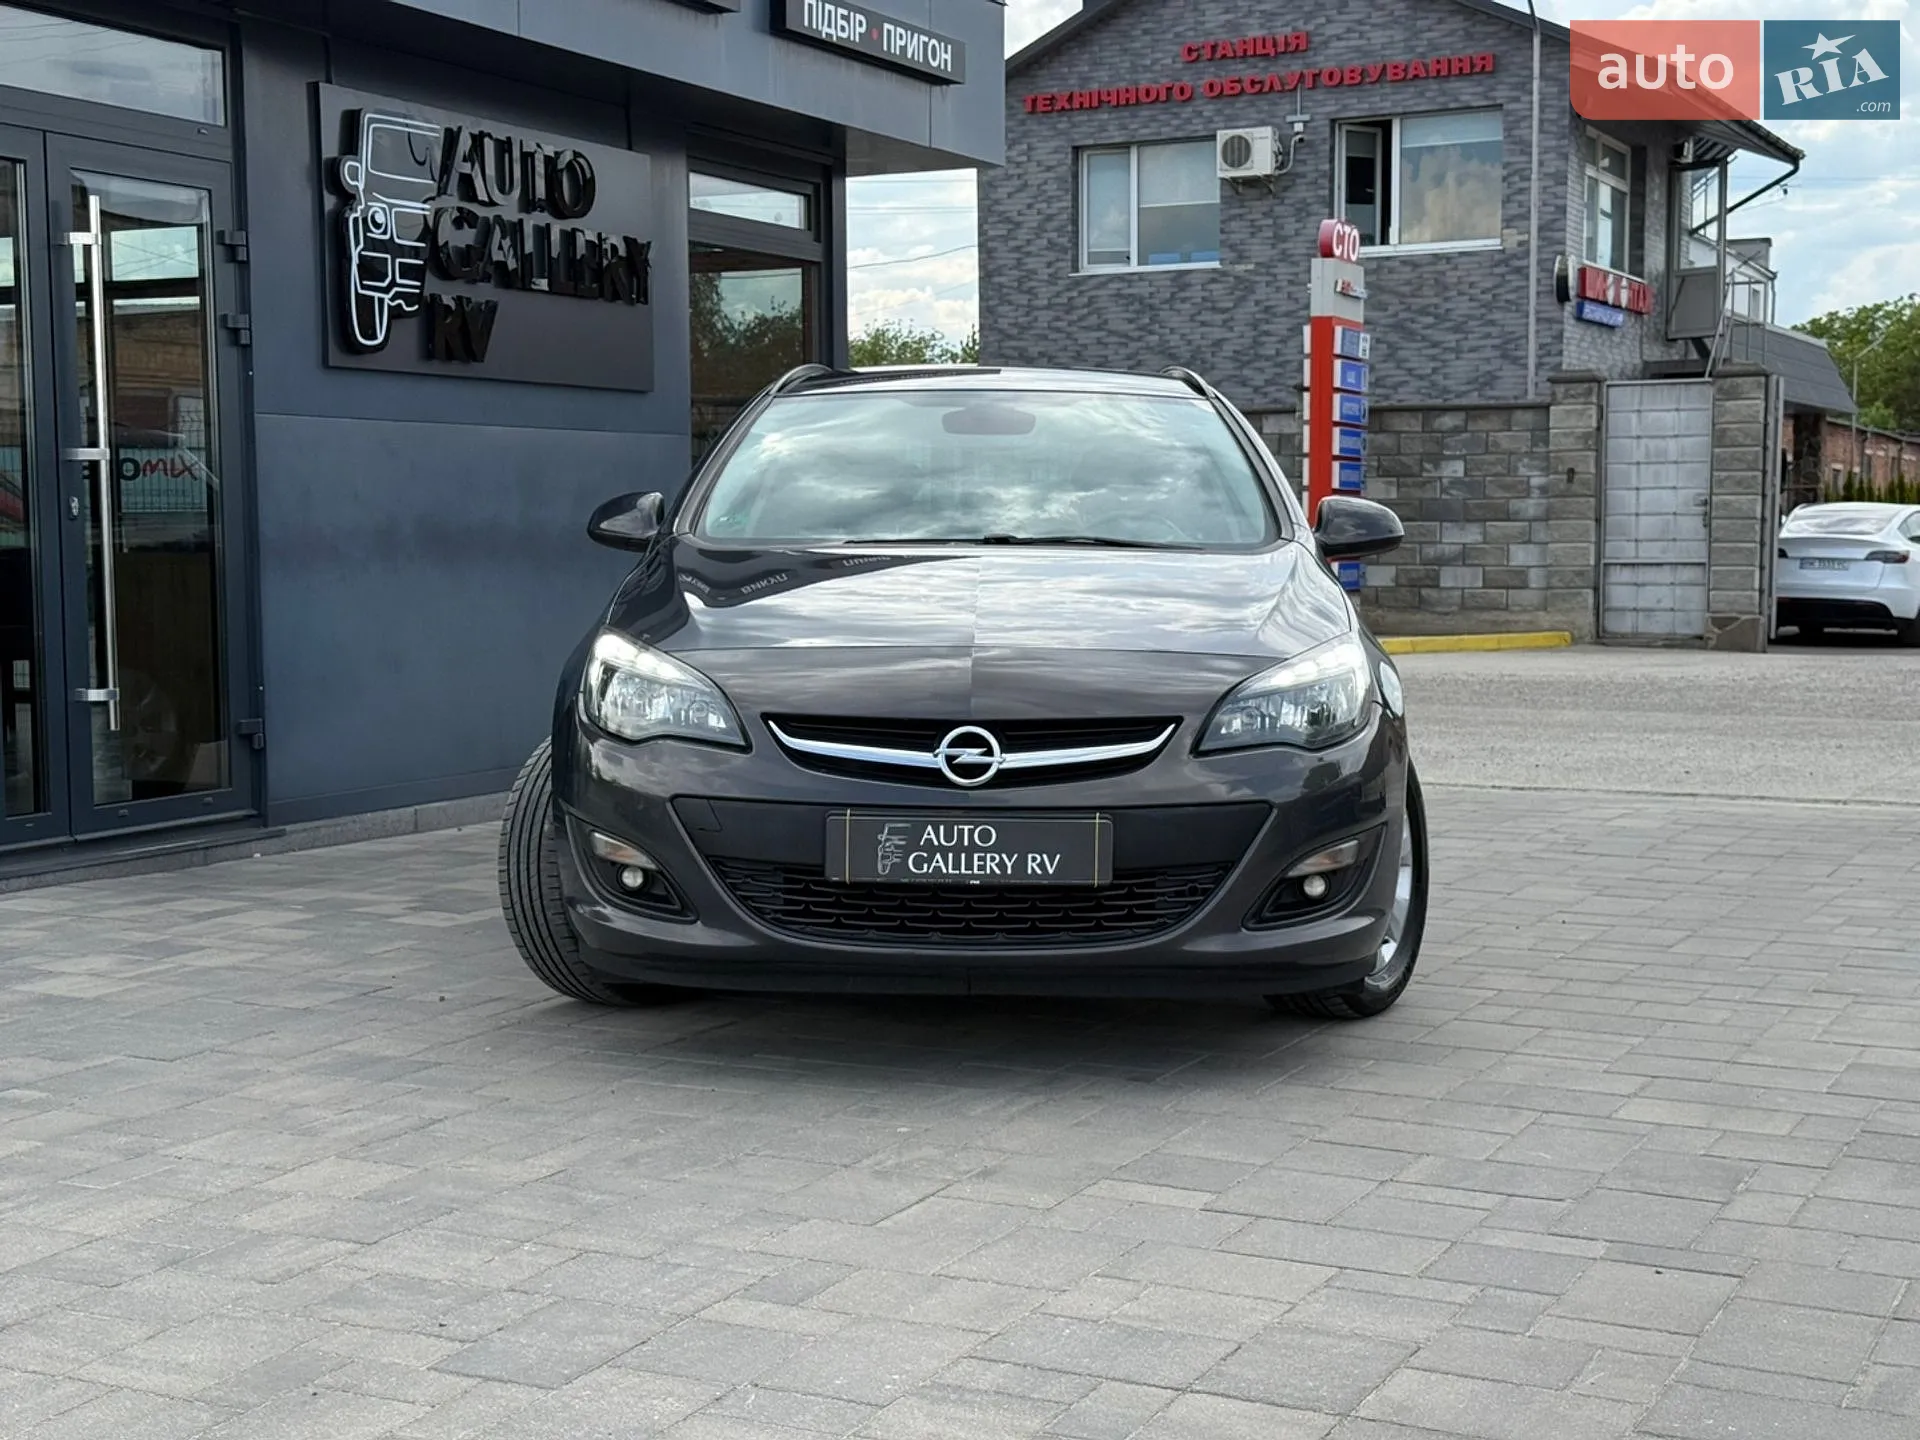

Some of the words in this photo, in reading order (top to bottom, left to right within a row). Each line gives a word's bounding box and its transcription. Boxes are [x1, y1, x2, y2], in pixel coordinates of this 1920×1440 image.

[803, 0, 867, 42] ПІДБІР
[882, 22, 952, 72] ПРИГОН
[1180, 31, 1309, 63] СТАНЦІЯ
[1023, 80, 1194, 115] ТЕХНІЧНОГО
[1202, 52, 1496, 99] ОБСЛУГОВУВАННЯ
[438, 125, 596, 220] AUTO
[427, 205, 653, 306] GALLERY
[1332, 222, 1361, 262] СТО
[428, 293, 499, 362] RV
[907, 852, 1018, 875] GALLERY
[1027, 853, 1061, 876] RV
[919, 824, 998, 848] AUTO
